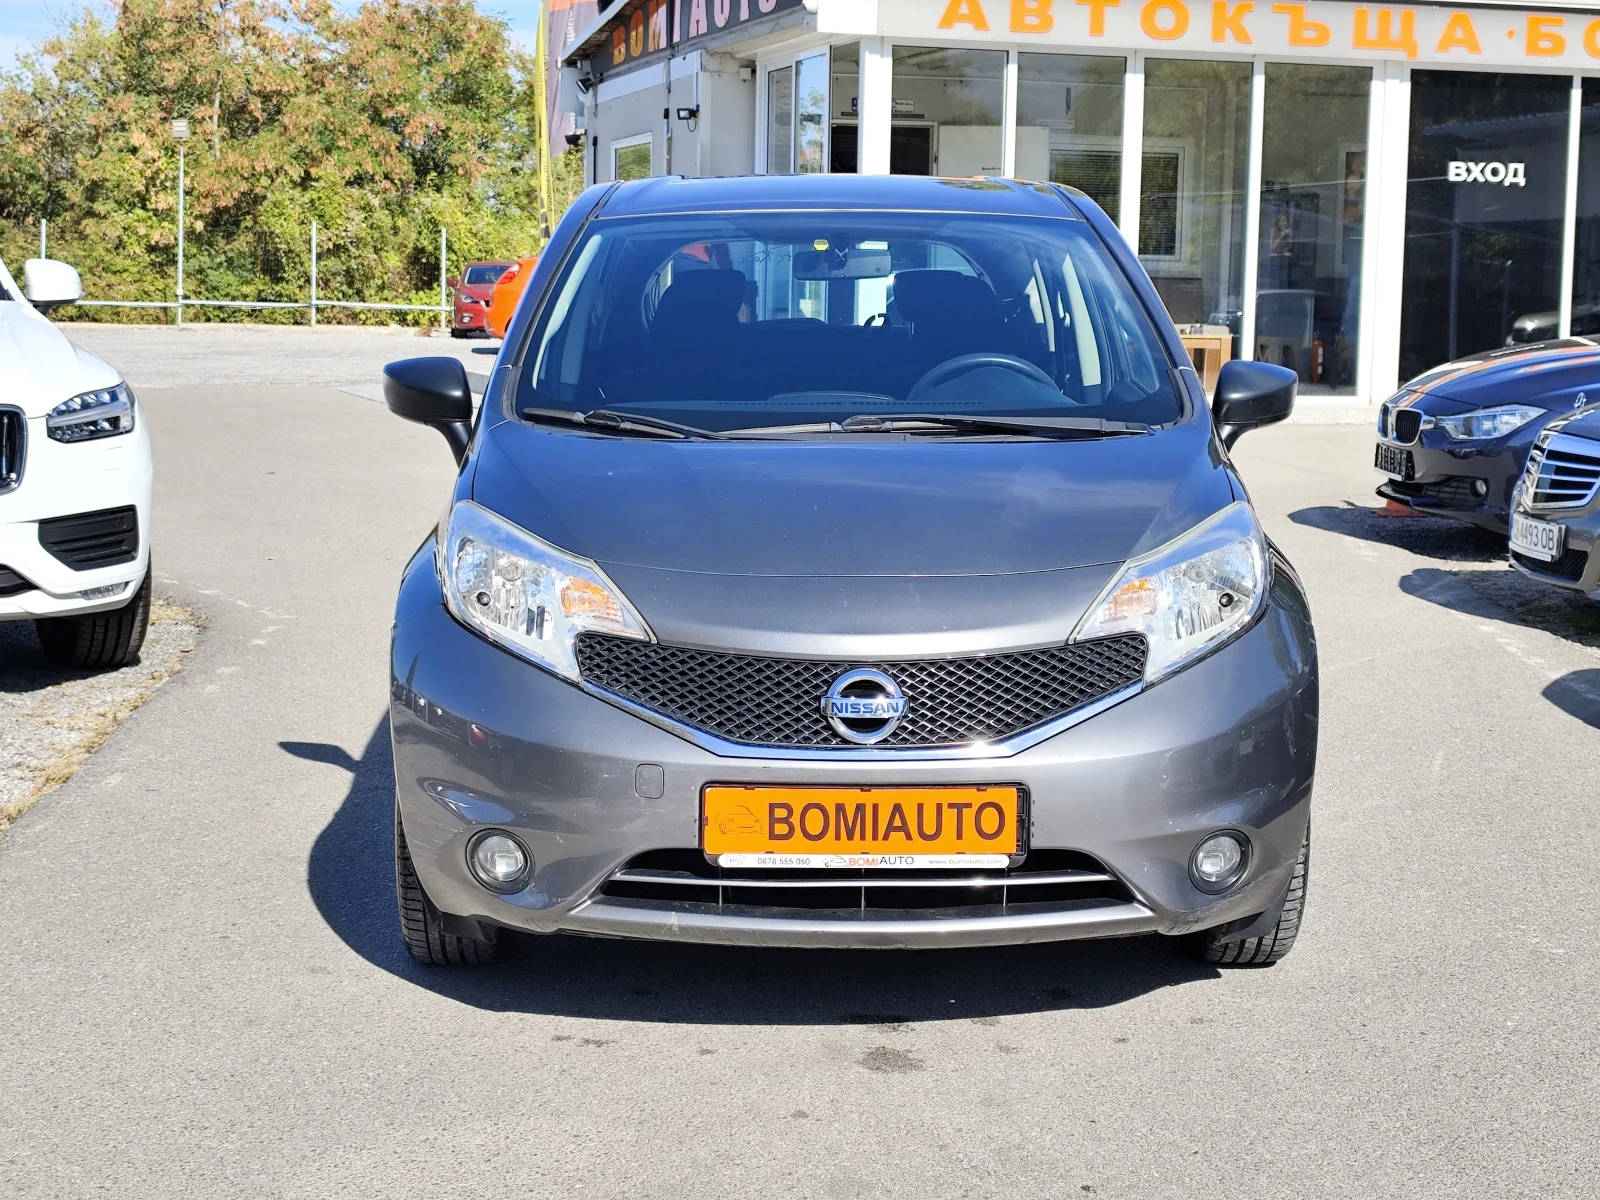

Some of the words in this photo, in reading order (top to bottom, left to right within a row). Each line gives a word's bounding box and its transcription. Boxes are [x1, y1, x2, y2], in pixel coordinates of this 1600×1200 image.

[937, 0, 1483, 59] АВТОКЪЩА
[1448, 161, 1526, 187] ВХОД
[1520, 521, 1539, 547] 4493
[831, 701, 900, 715] NISSAN
[768, 802, 1006, 842] BOMIAUTO
[757, 857, 777, 865] 0878
[779, 857, 794, 865] 555
